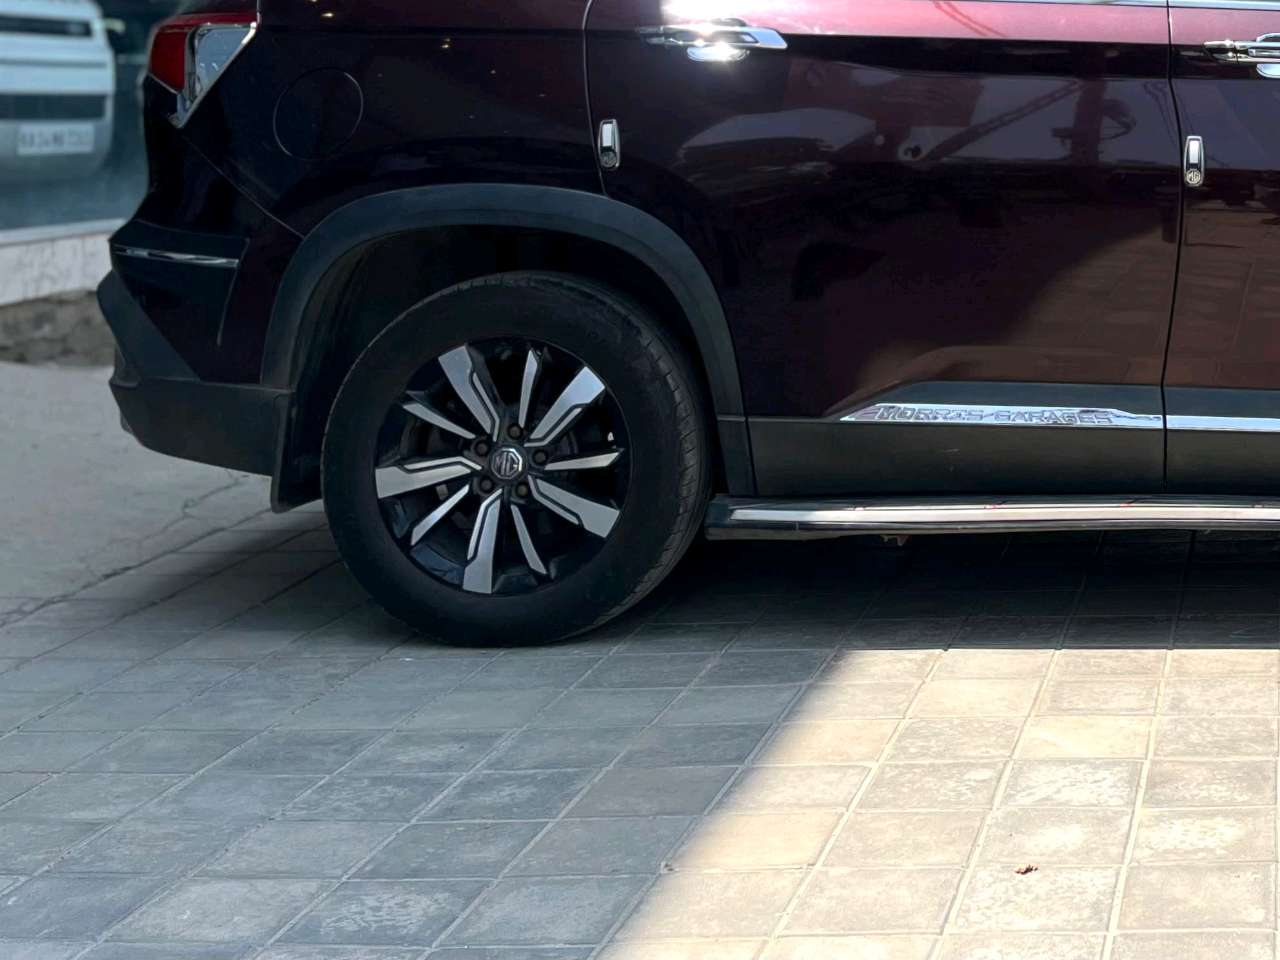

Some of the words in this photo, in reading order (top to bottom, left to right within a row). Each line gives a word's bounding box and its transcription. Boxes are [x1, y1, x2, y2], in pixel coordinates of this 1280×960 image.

[875, 405, 984, 421] MORRIS
[994, 408, 1113, 424] GARAGES
[493, 450, 521, 478] MG
